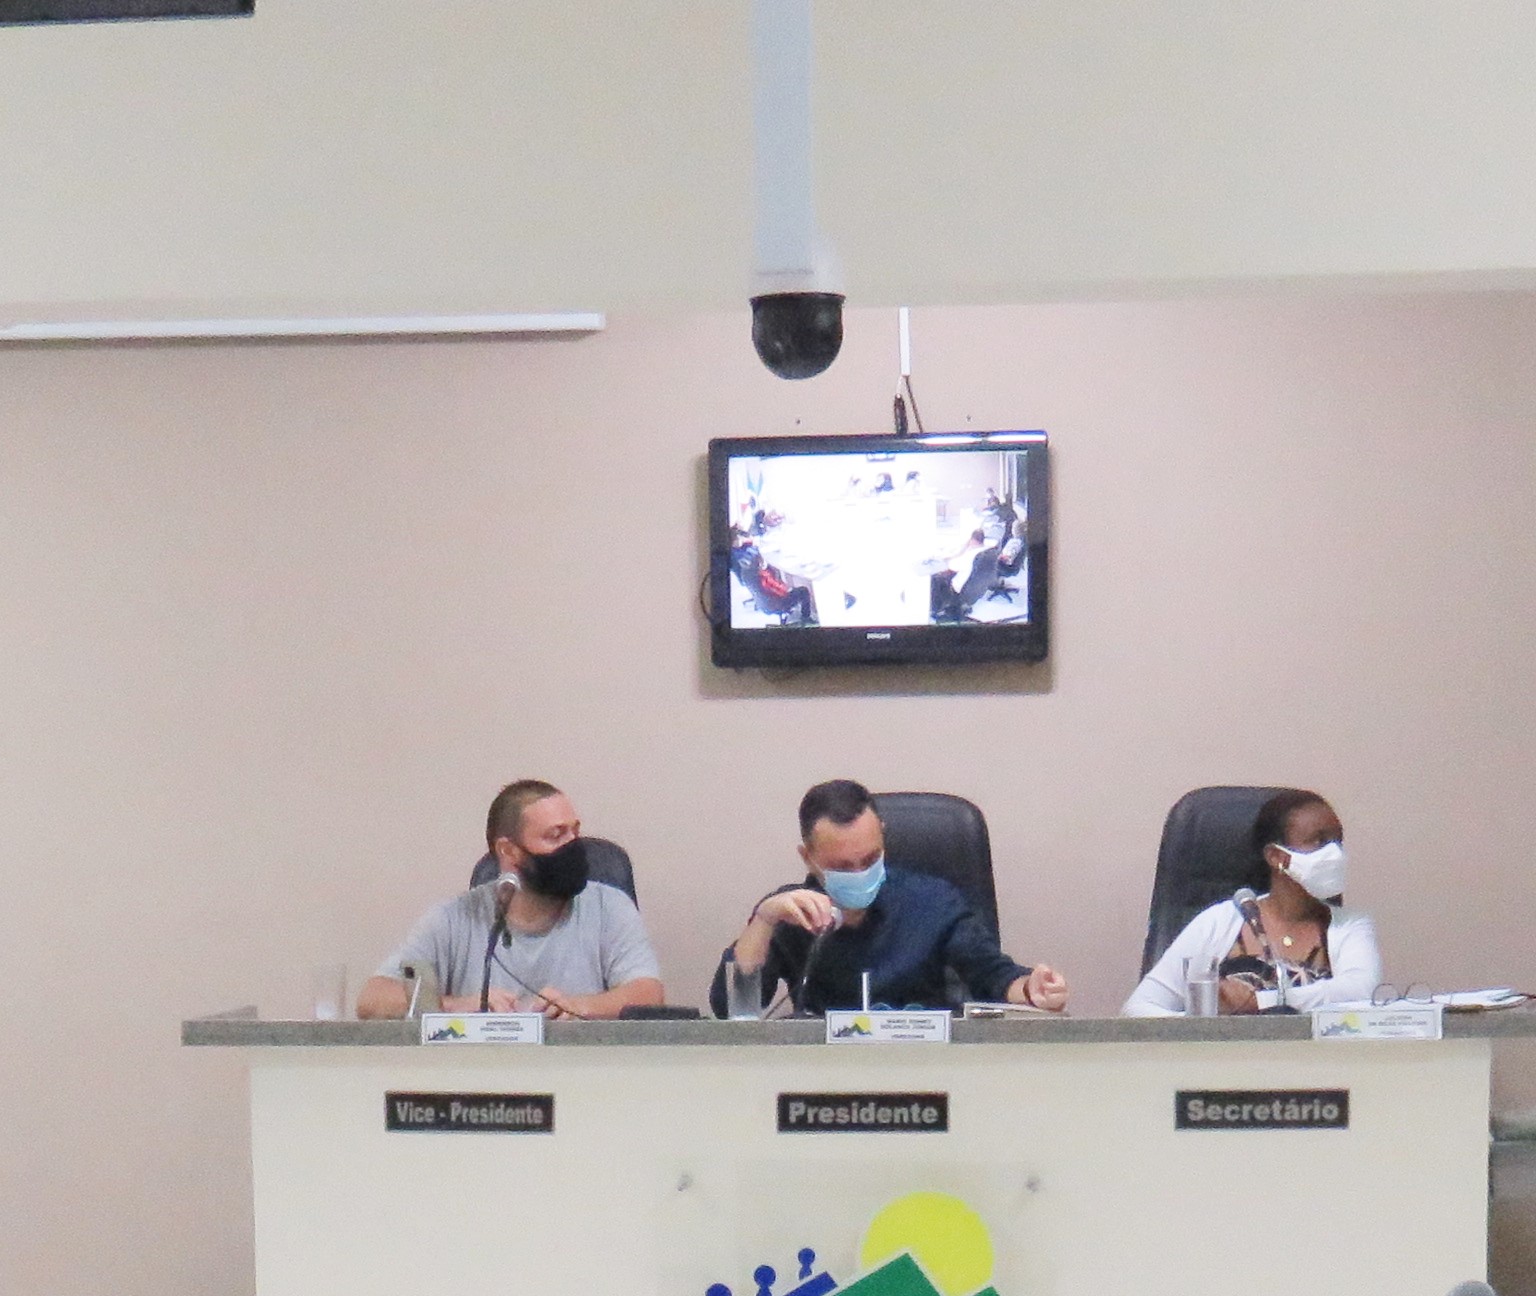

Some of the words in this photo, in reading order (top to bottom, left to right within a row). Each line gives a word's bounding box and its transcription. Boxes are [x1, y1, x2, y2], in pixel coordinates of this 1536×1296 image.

[396, 1101, 435, 1123] Vice
[450, 1101, 544, 1124] Presidente
[788, 1101, 939, 1124] Presidente
[1187, 1098, 1340, 1121] Secretário
